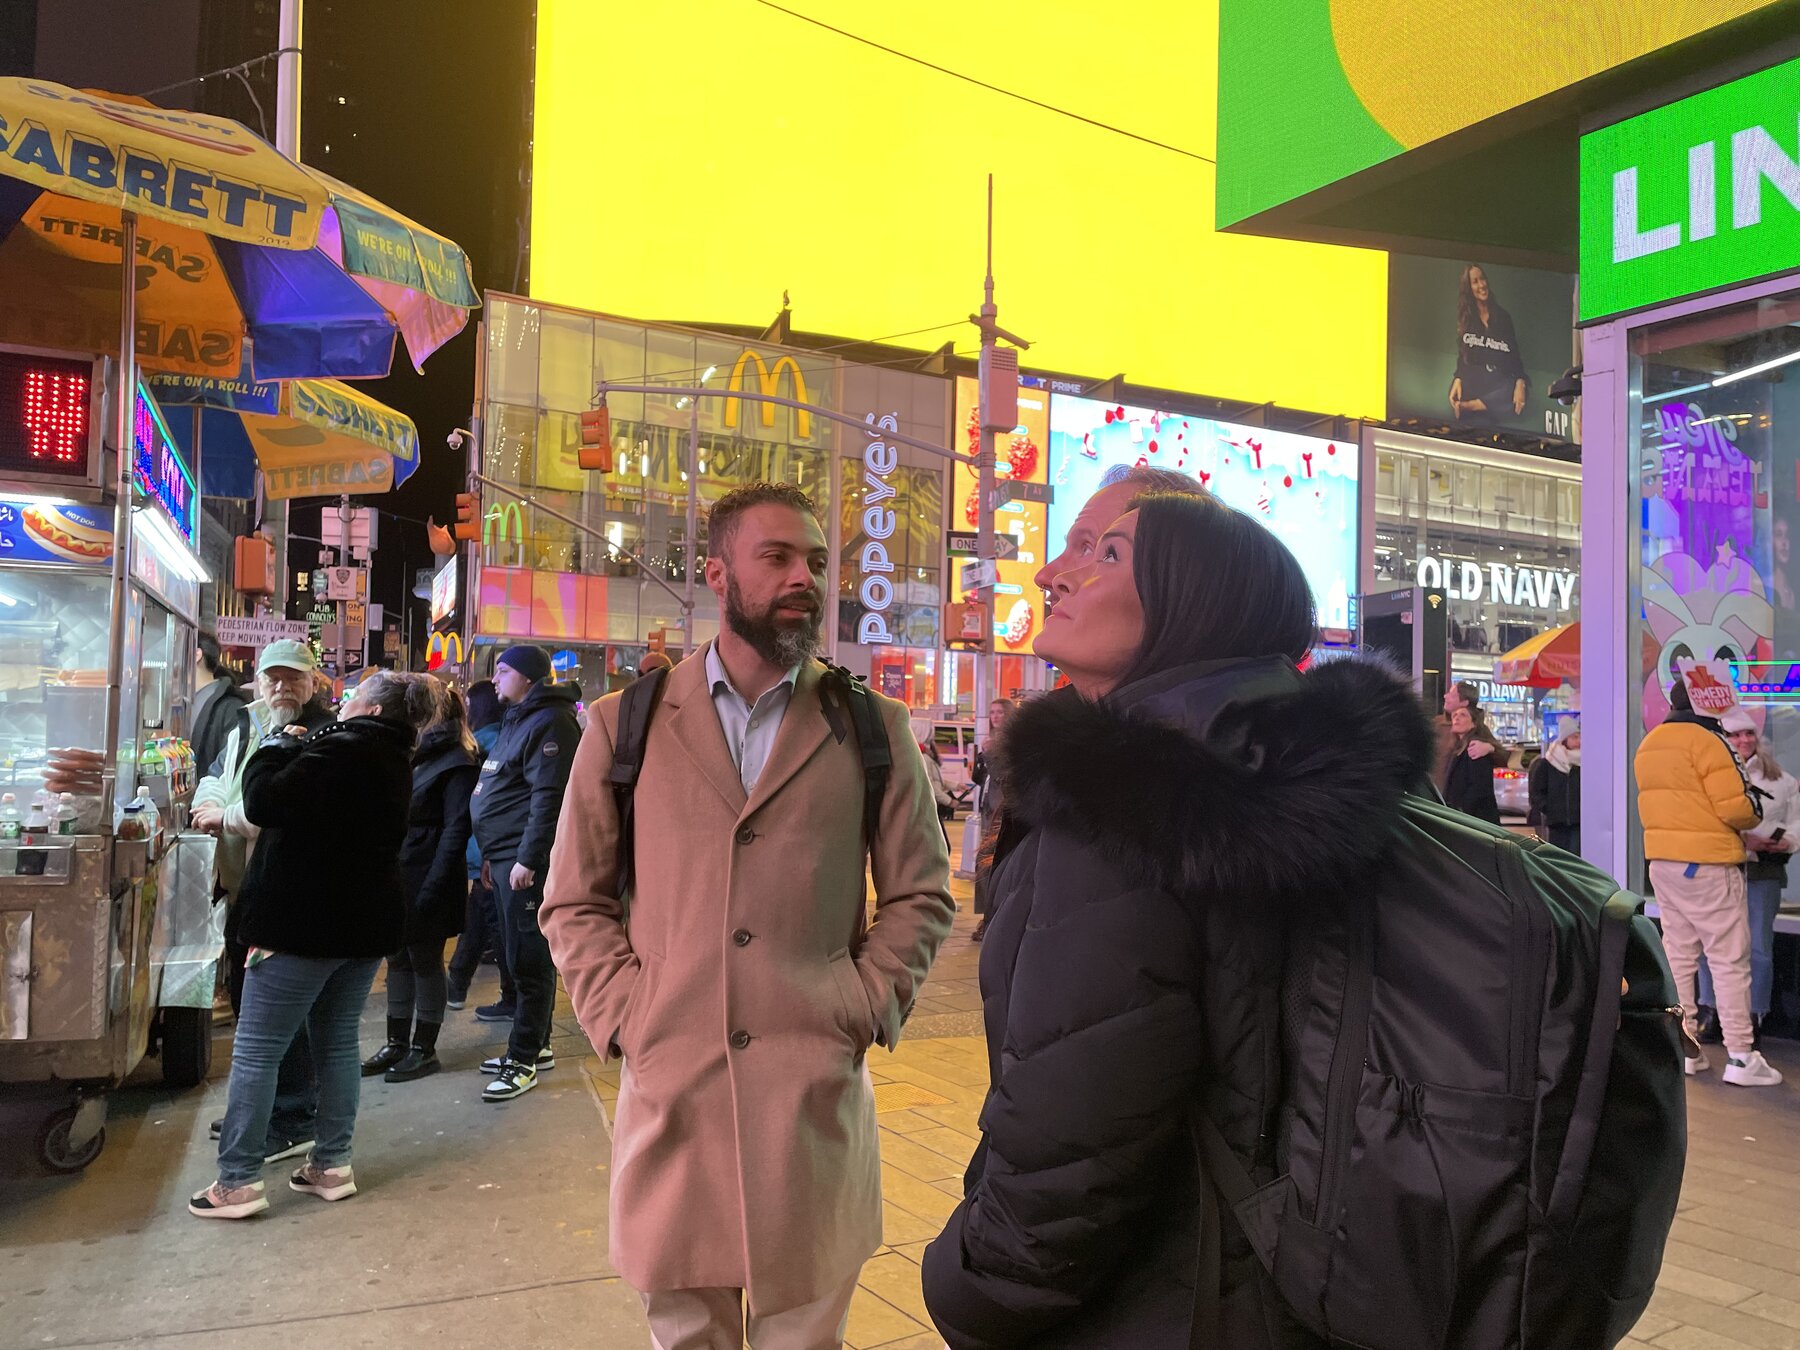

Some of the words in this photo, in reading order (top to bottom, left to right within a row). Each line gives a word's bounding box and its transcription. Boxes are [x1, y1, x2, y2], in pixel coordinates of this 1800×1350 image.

[0, 112, 308, 237] ABRETT
[357, 229, 393, 256] WE'RE
[184, 376, 200, 388] ON
[205, 379, 214, 389] A
[219, 379, 248, 394] ROLL
[1051, 380, 1082, 394] PRIME
[1545, 410, 1568, 437] GAP
[65, 511, 79, 521] HOT
[79, 516, 96, 527] DOG
[956, 539, 978, 550] ONE
[1417, 556, 1483, 601] OLD
[1488, 563, 1576, 610] NAVY
[314, 603, 331, 612] PUB
[218, 618, 264, 631] PEDESTRIAN
[266, 622, 287, 633] FLOW
[287, 623, 307, 634] ZONE
[218, 631, 236, 642] KEEP
[238, 633, 267, 644] MOVING
[1491, 683, 1527, 701] NAVY
[1688, 685, 1731, 701] COMEDY
